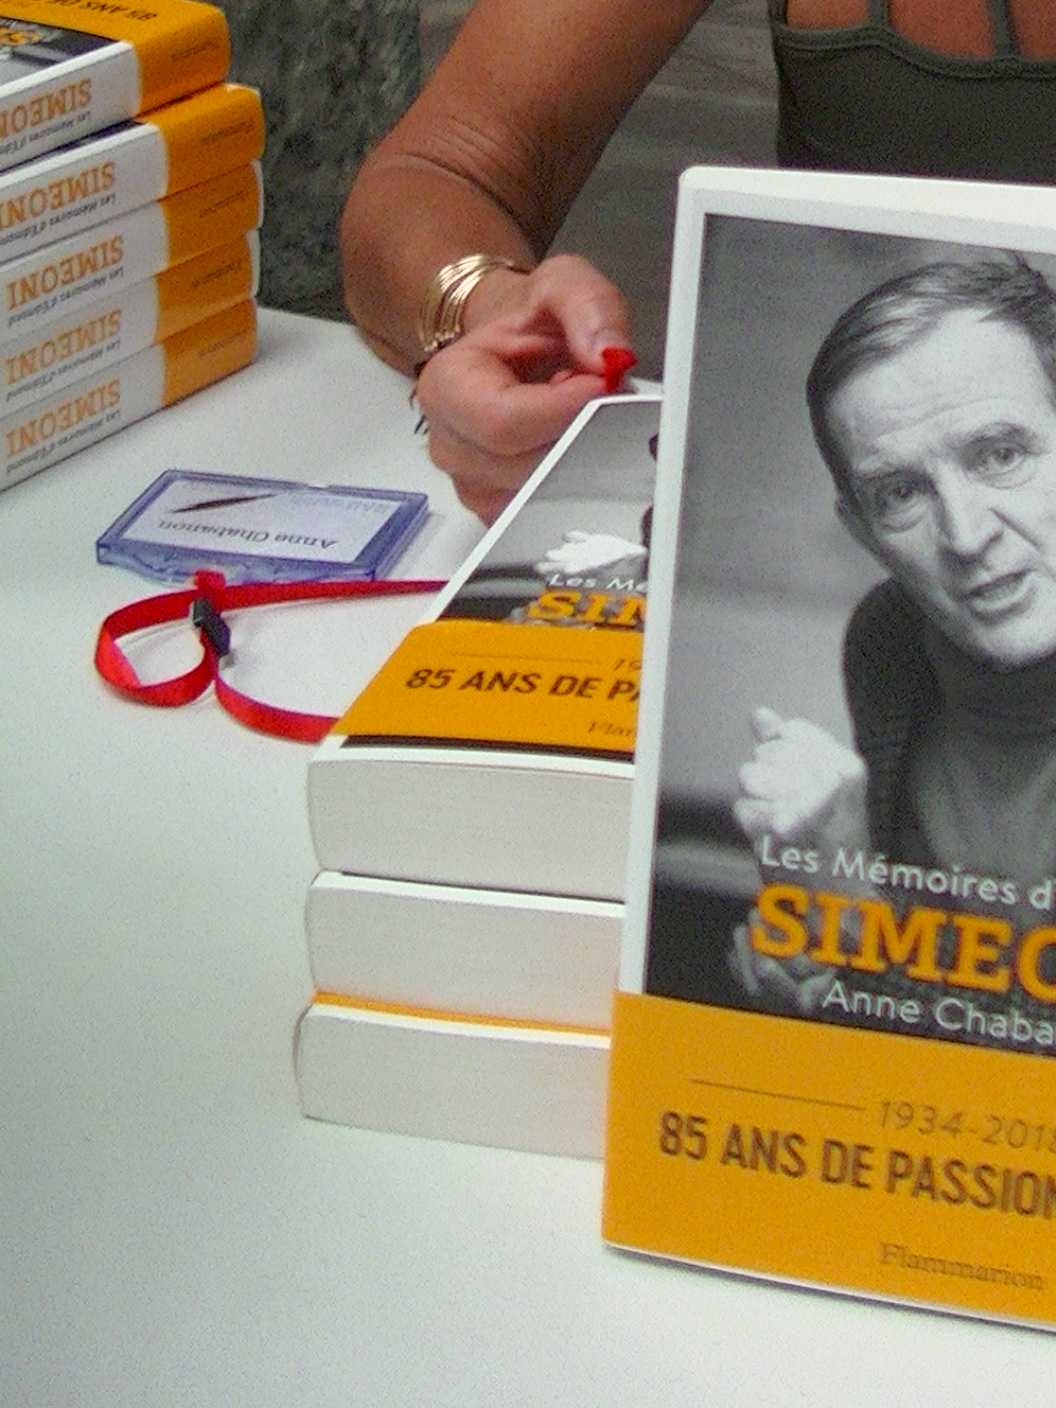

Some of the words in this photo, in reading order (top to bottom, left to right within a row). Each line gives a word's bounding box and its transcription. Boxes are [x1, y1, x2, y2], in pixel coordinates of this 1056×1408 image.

[6, 233, 124, 311] SIMEONI
[5, 307, 122, 386] SIMEONI
[5, 377, 121, 459] SIMEONI
[550, 573, 598, 588] Les
[405, 668, 456, 691] 85
[458, 669, 542, 694] ANS
[548, 674, 603, 699] DE
[760, 834, 820, 874] Les
[831, 846, 1019, 906] Mémoires
[821, 979, 921, 1024] Anne
[659, 1110, 709, 1161] 85
[719, 1122, 808, 1179] ANS
[819, 1137, 874, 1190] DE
[879, 1242, 1045, 1290] Flammarion
